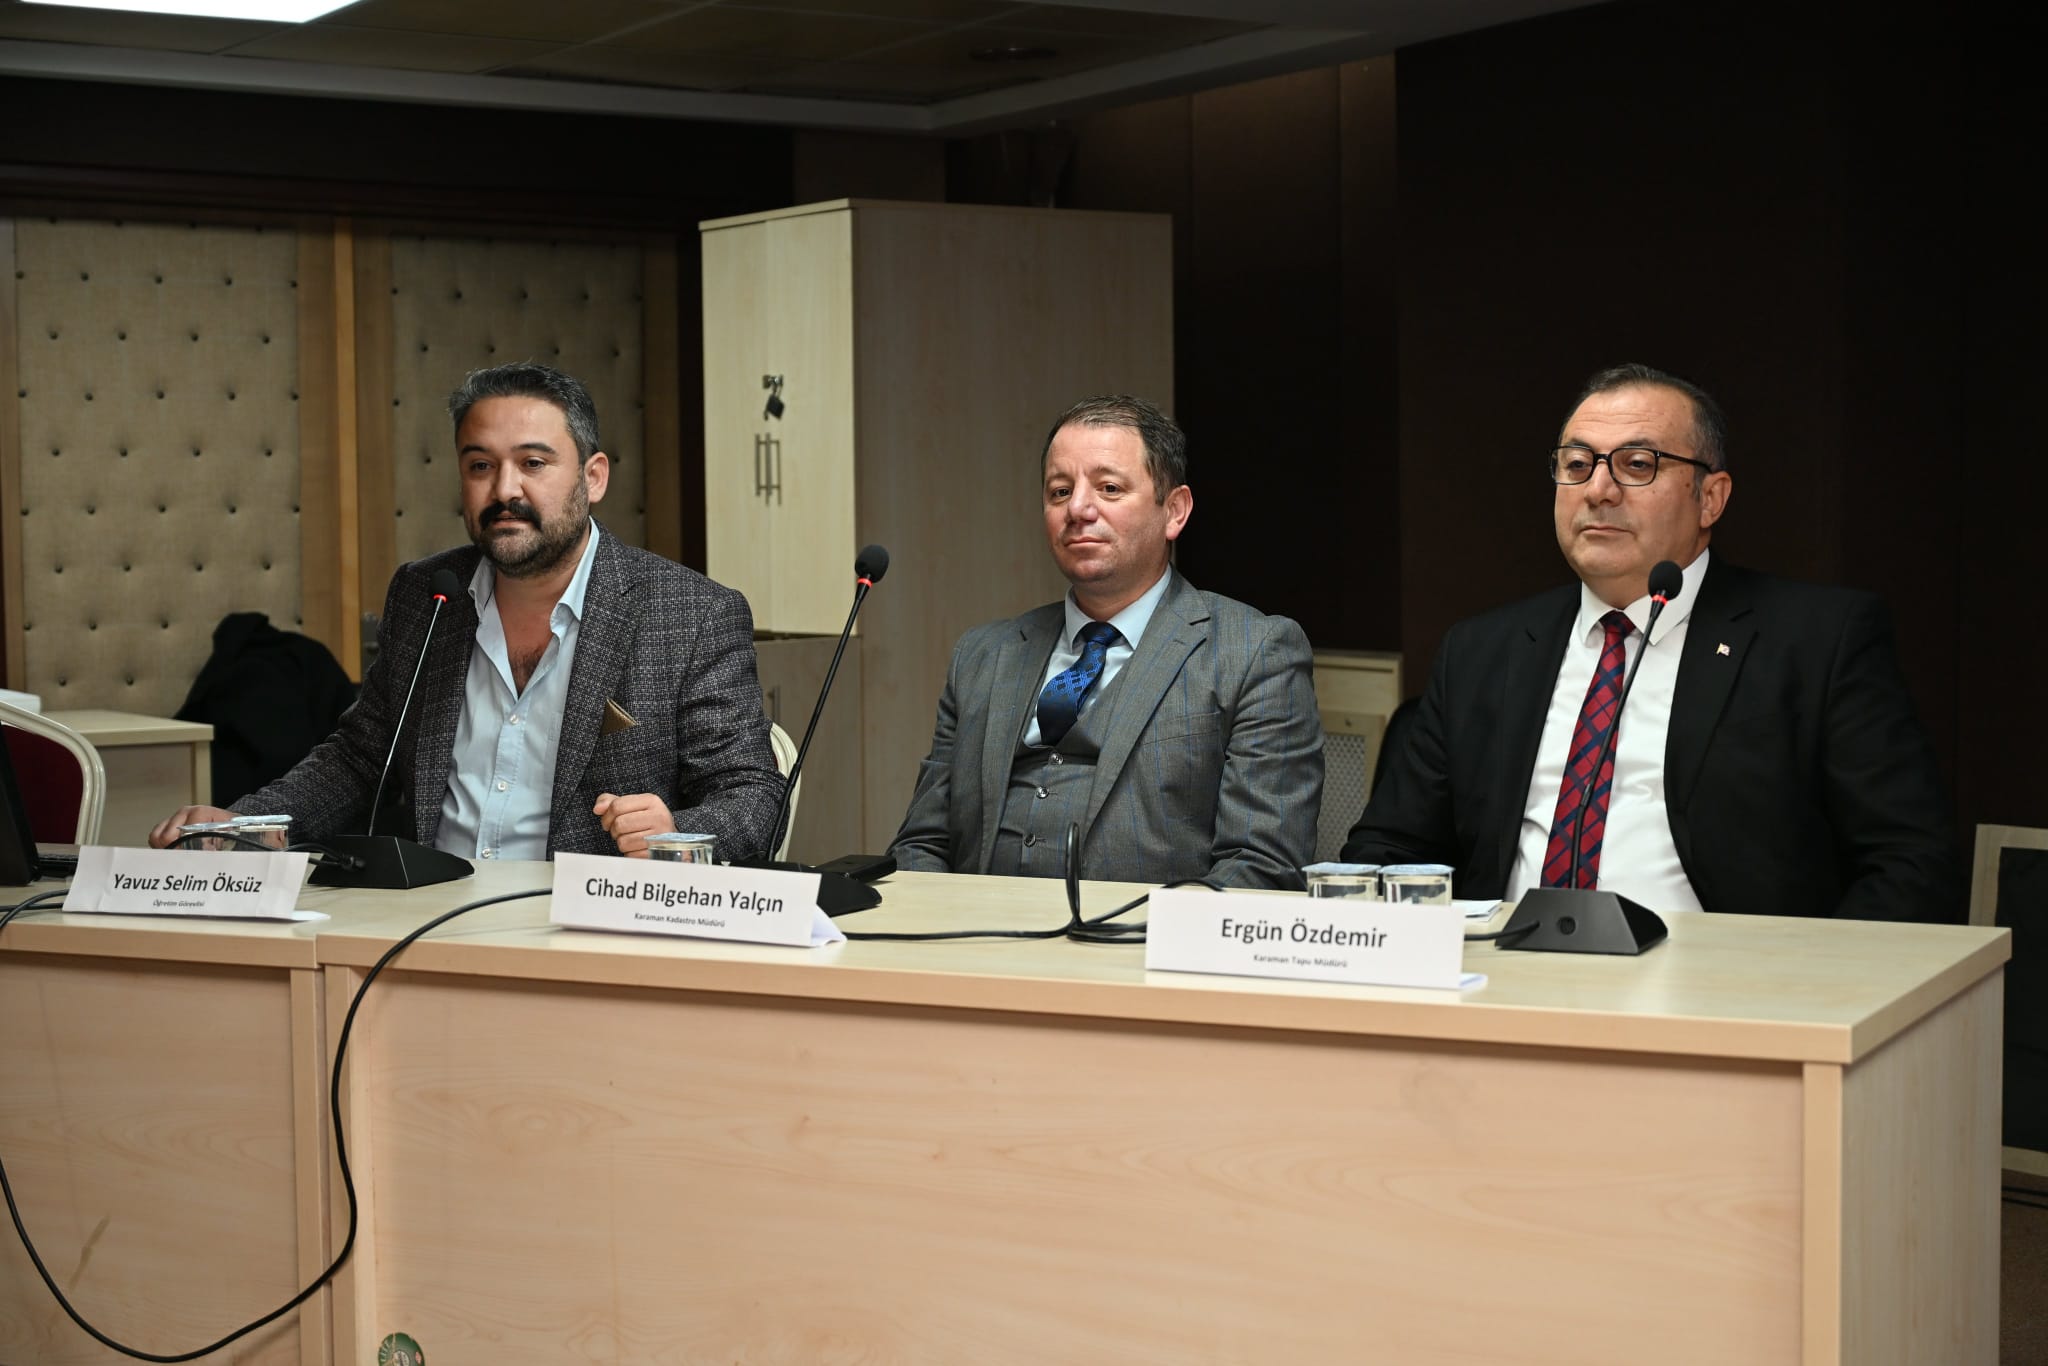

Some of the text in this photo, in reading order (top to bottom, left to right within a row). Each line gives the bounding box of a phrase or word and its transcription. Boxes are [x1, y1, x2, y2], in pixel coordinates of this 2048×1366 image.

[113, 872, 262, 893] Yavuz Selim Öksüz
[585, 878, 784, 915] Cihad Bilgehan Yalçın
[634, 912, 726, 928] Karaman Kadastro Müdürü
[1221, 917, 1388, 948] Ergün Özdemir
[1253, 953, 1348, 968] Karaman Tapu Müdürü
